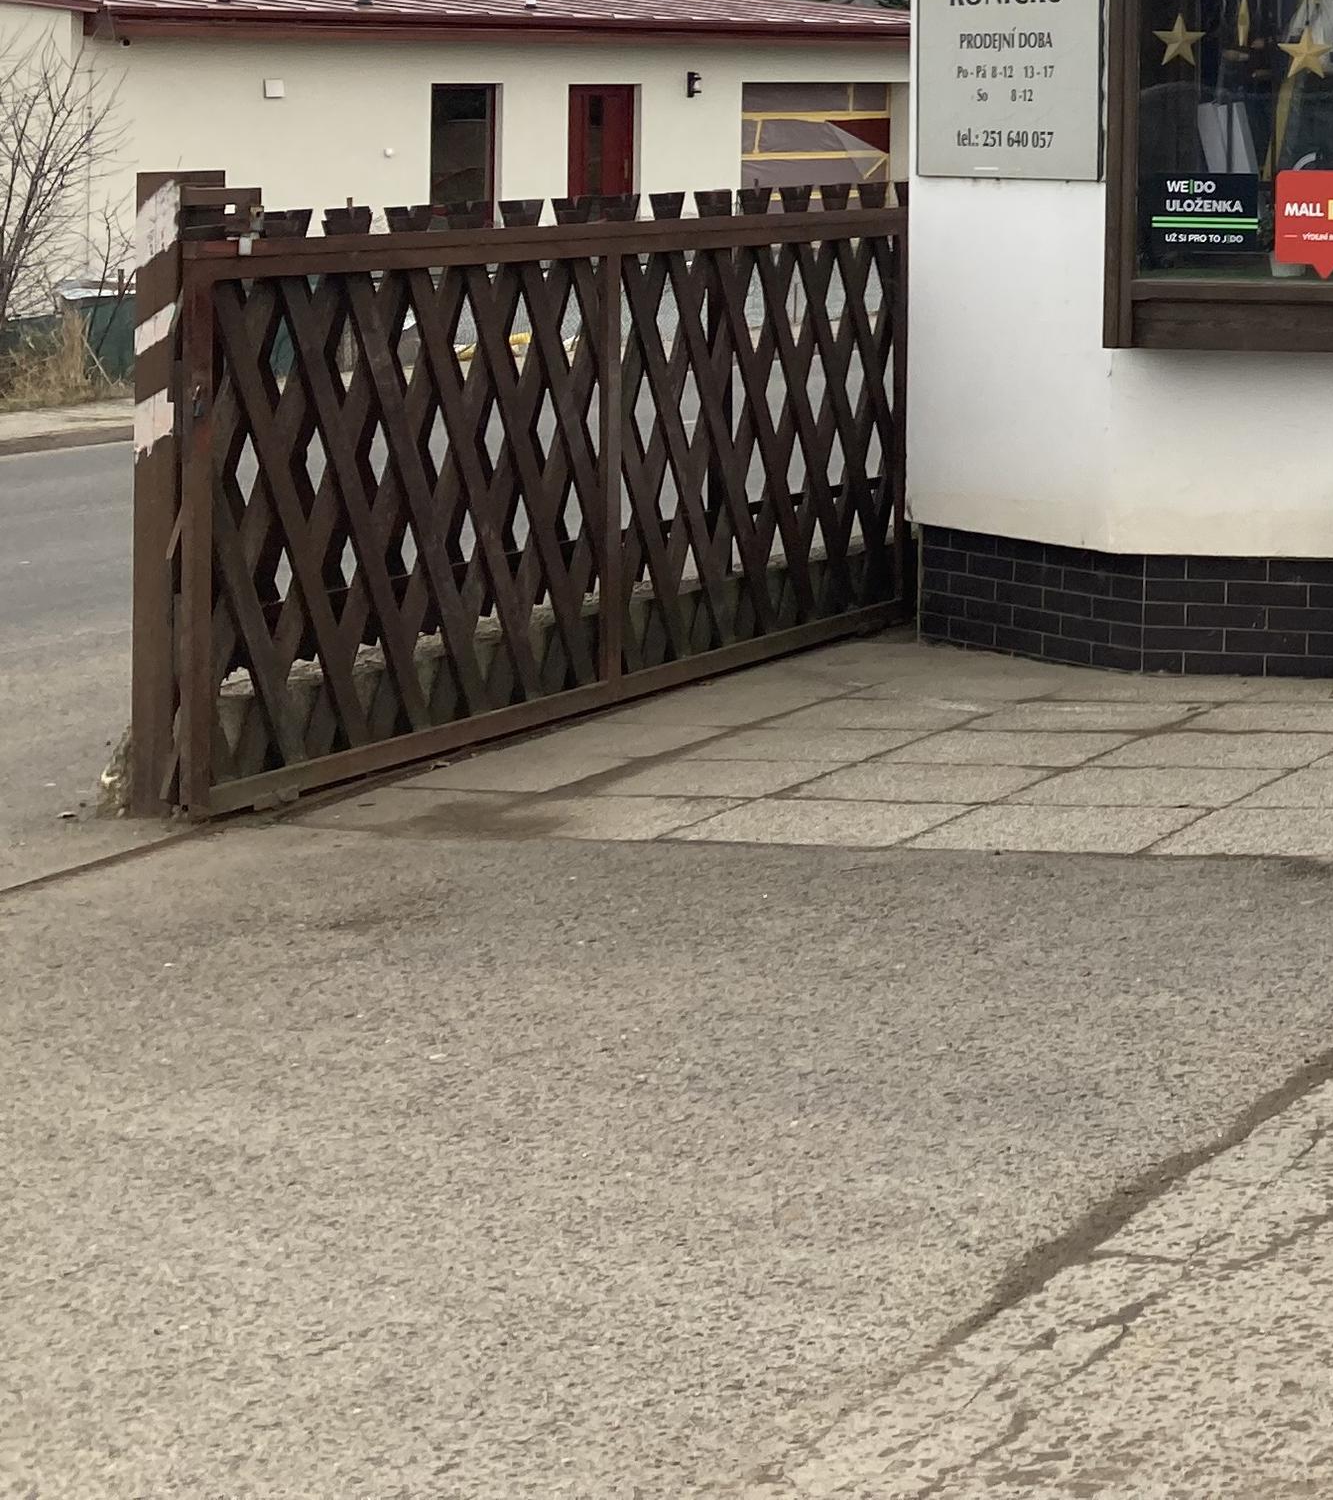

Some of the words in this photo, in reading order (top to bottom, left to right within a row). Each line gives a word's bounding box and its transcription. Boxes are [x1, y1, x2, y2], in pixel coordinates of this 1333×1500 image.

[959, 27, 1016, 52] PRODEJNÍ
[1018, 32, 1053, 49] DOBA
[976, 88, 989, 102] So
[982, 129, 1003, 148] 251
[1006, 129, 1029, 148] 640
[1031, 130, 1055, 149] 057
[1165, 197, 1244, 213] ULOŽENKA
[1284, 202, 1325, 218] MALL
[1188, 233, 1207, 243] PRO
[1208, 234, 1221, 243] TO
